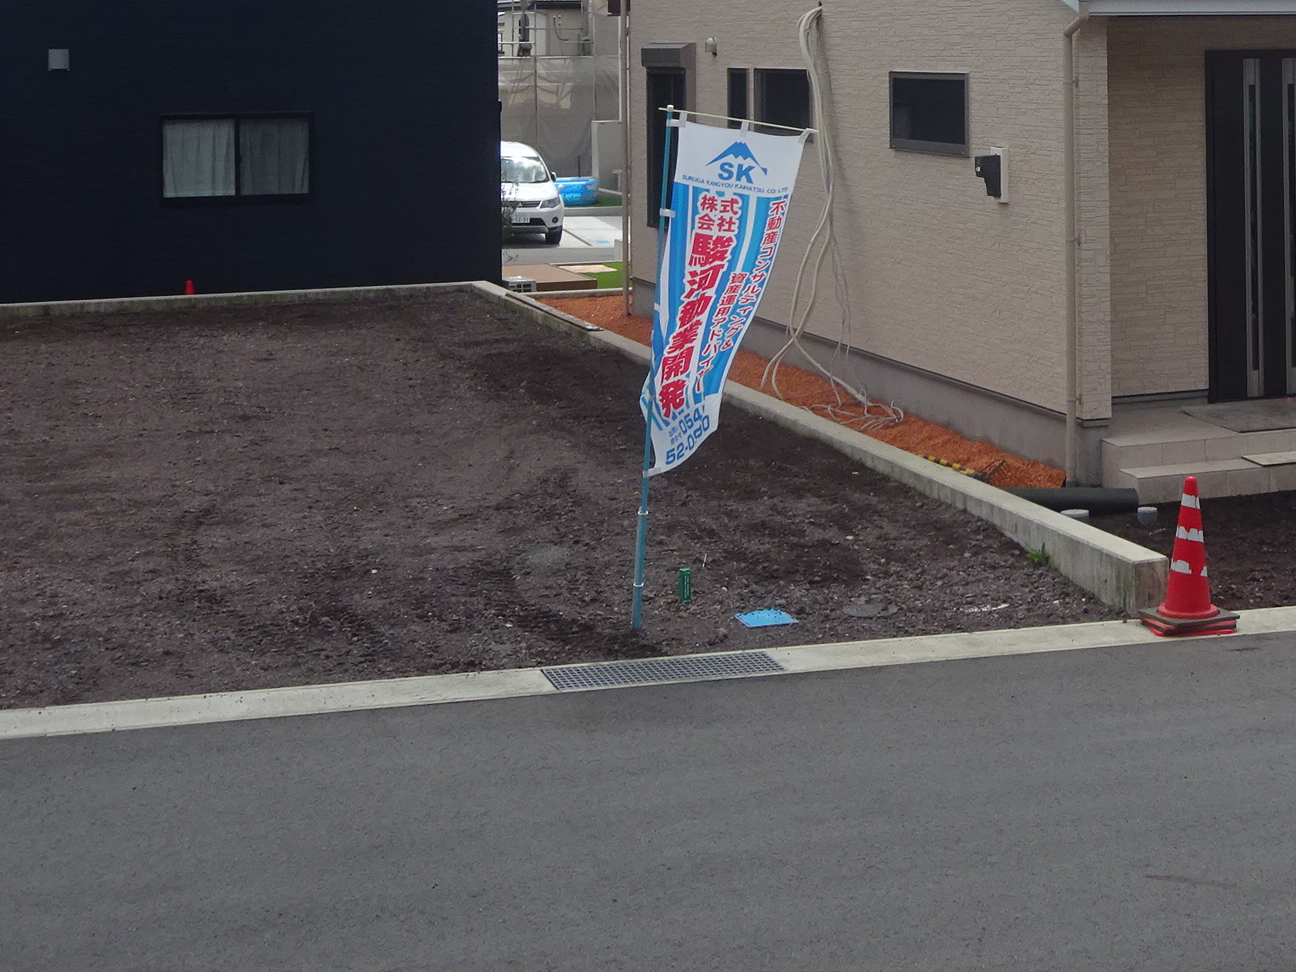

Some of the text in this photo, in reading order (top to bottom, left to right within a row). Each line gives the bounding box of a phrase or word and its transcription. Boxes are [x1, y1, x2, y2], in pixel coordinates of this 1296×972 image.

[682, 174, 705, 184] SURUGA
[706, 179, 734, 188] KANGYOU
[718, 162, 755, 184] SK
[658, 233, 733, 419] 駿河勧業開発
